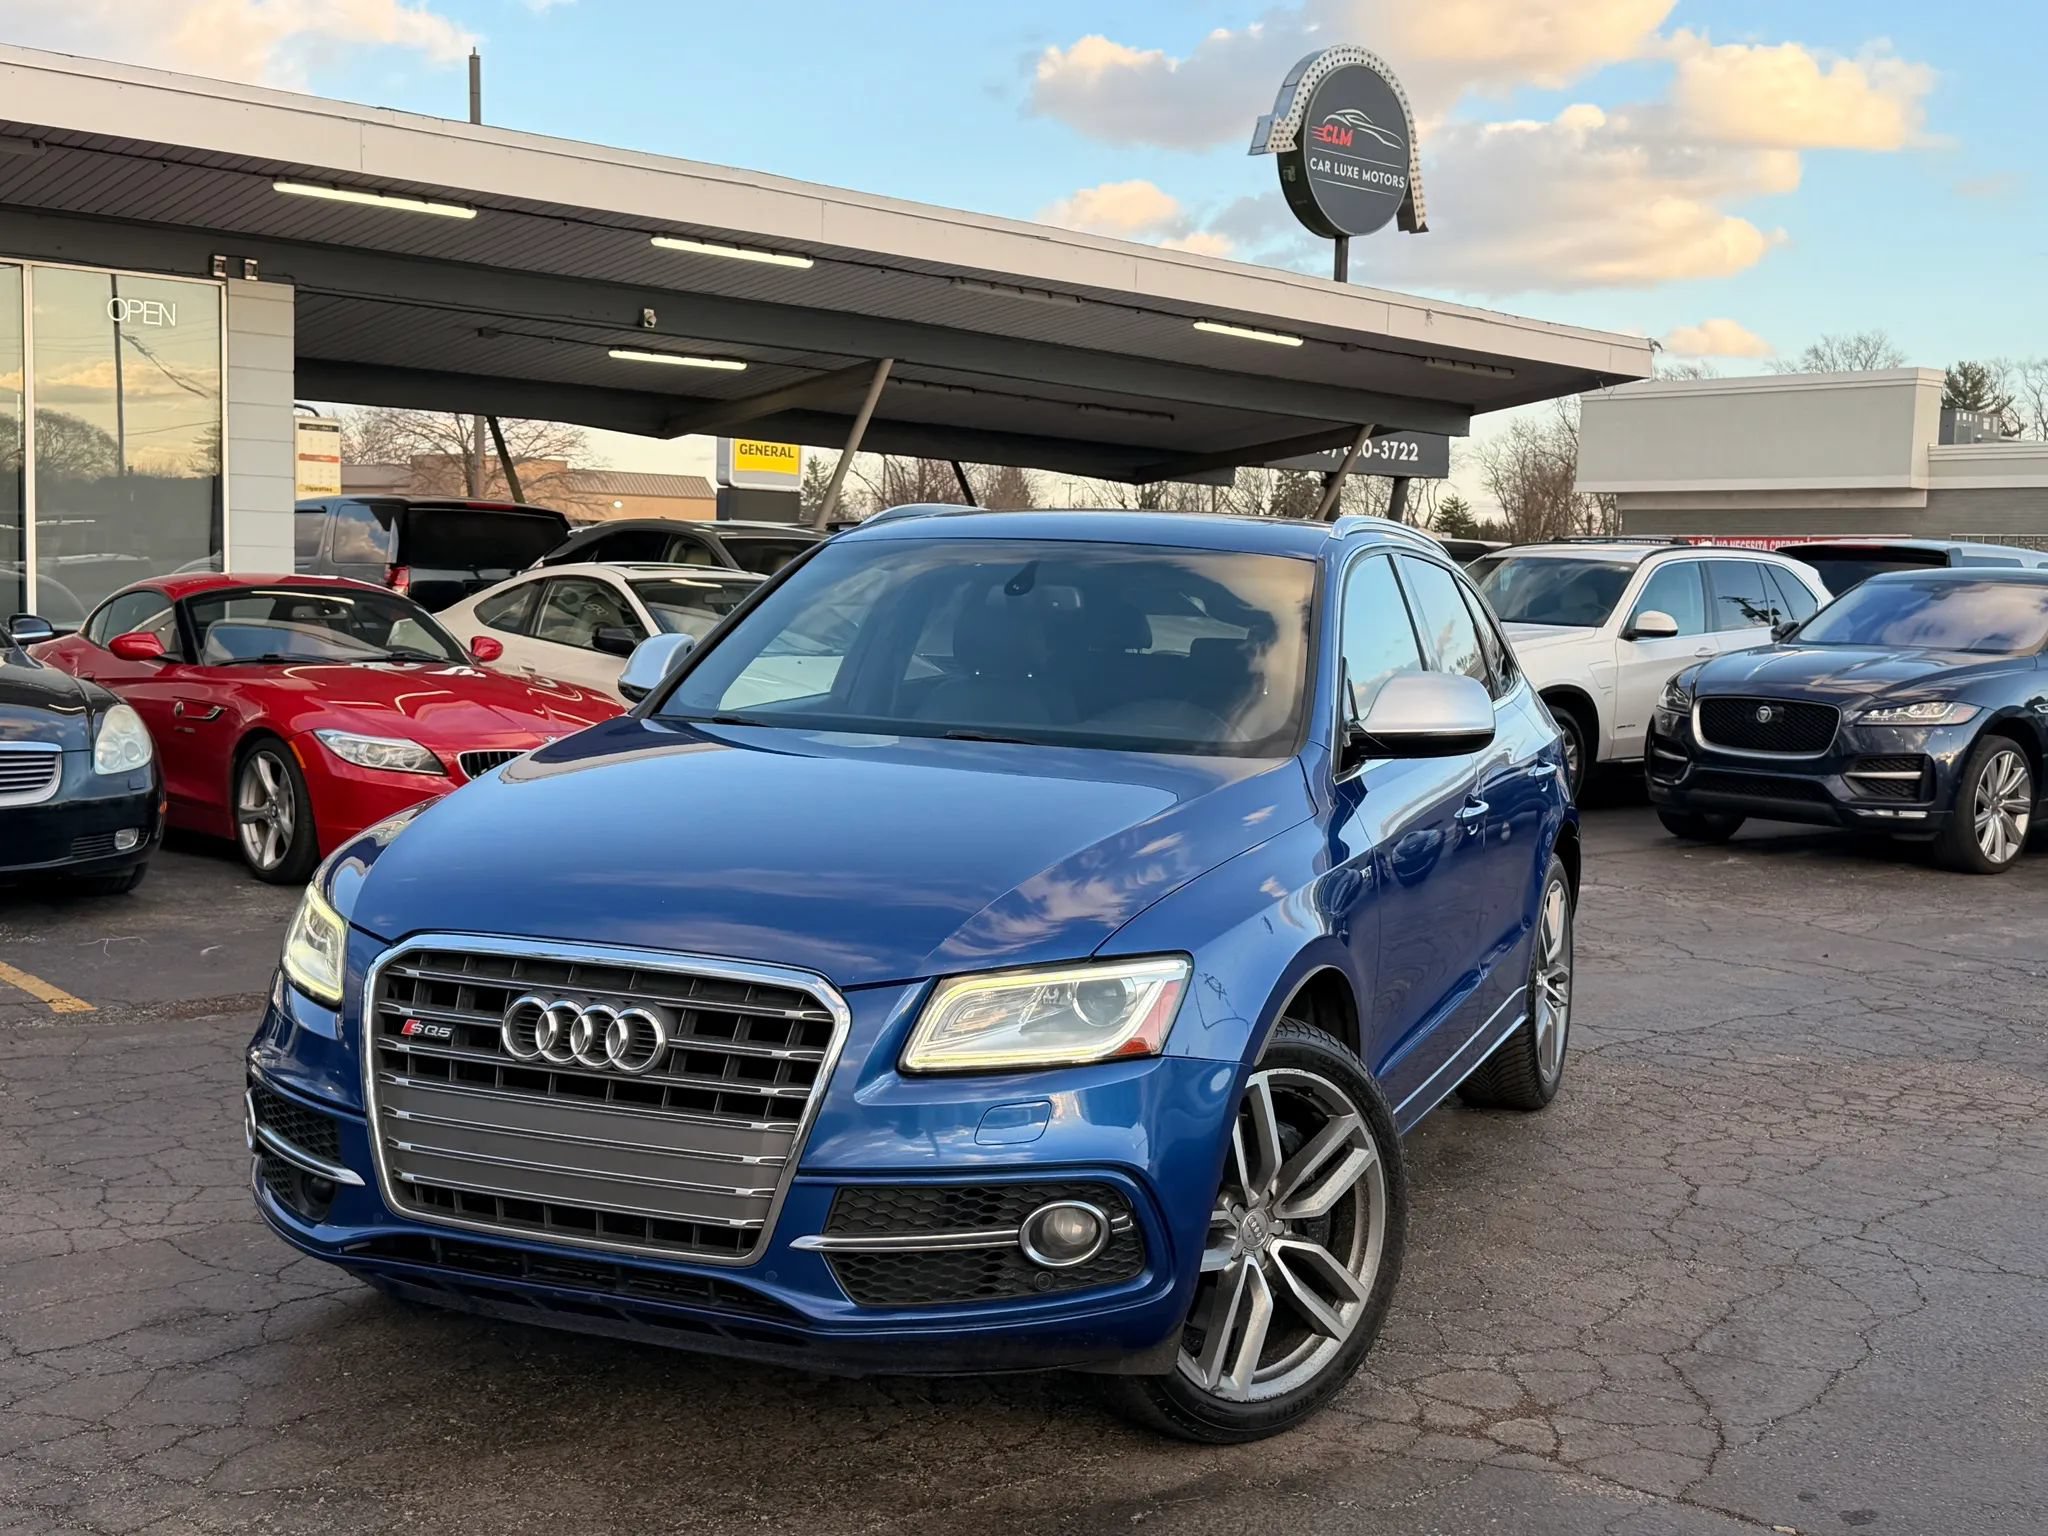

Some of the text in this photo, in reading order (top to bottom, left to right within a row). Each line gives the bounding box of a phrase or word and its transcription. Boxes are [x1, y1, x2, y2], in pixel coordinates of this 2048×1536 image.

[1322, 124, 1354, 147] CLM
[1310, 157, 1405, 189] CAR LUXE MOTORS
[107, 297, 176, 326] OPEN
[739, 443, 795, 459] GENERAL
[401, 1019, 453, 1038] SQ5
